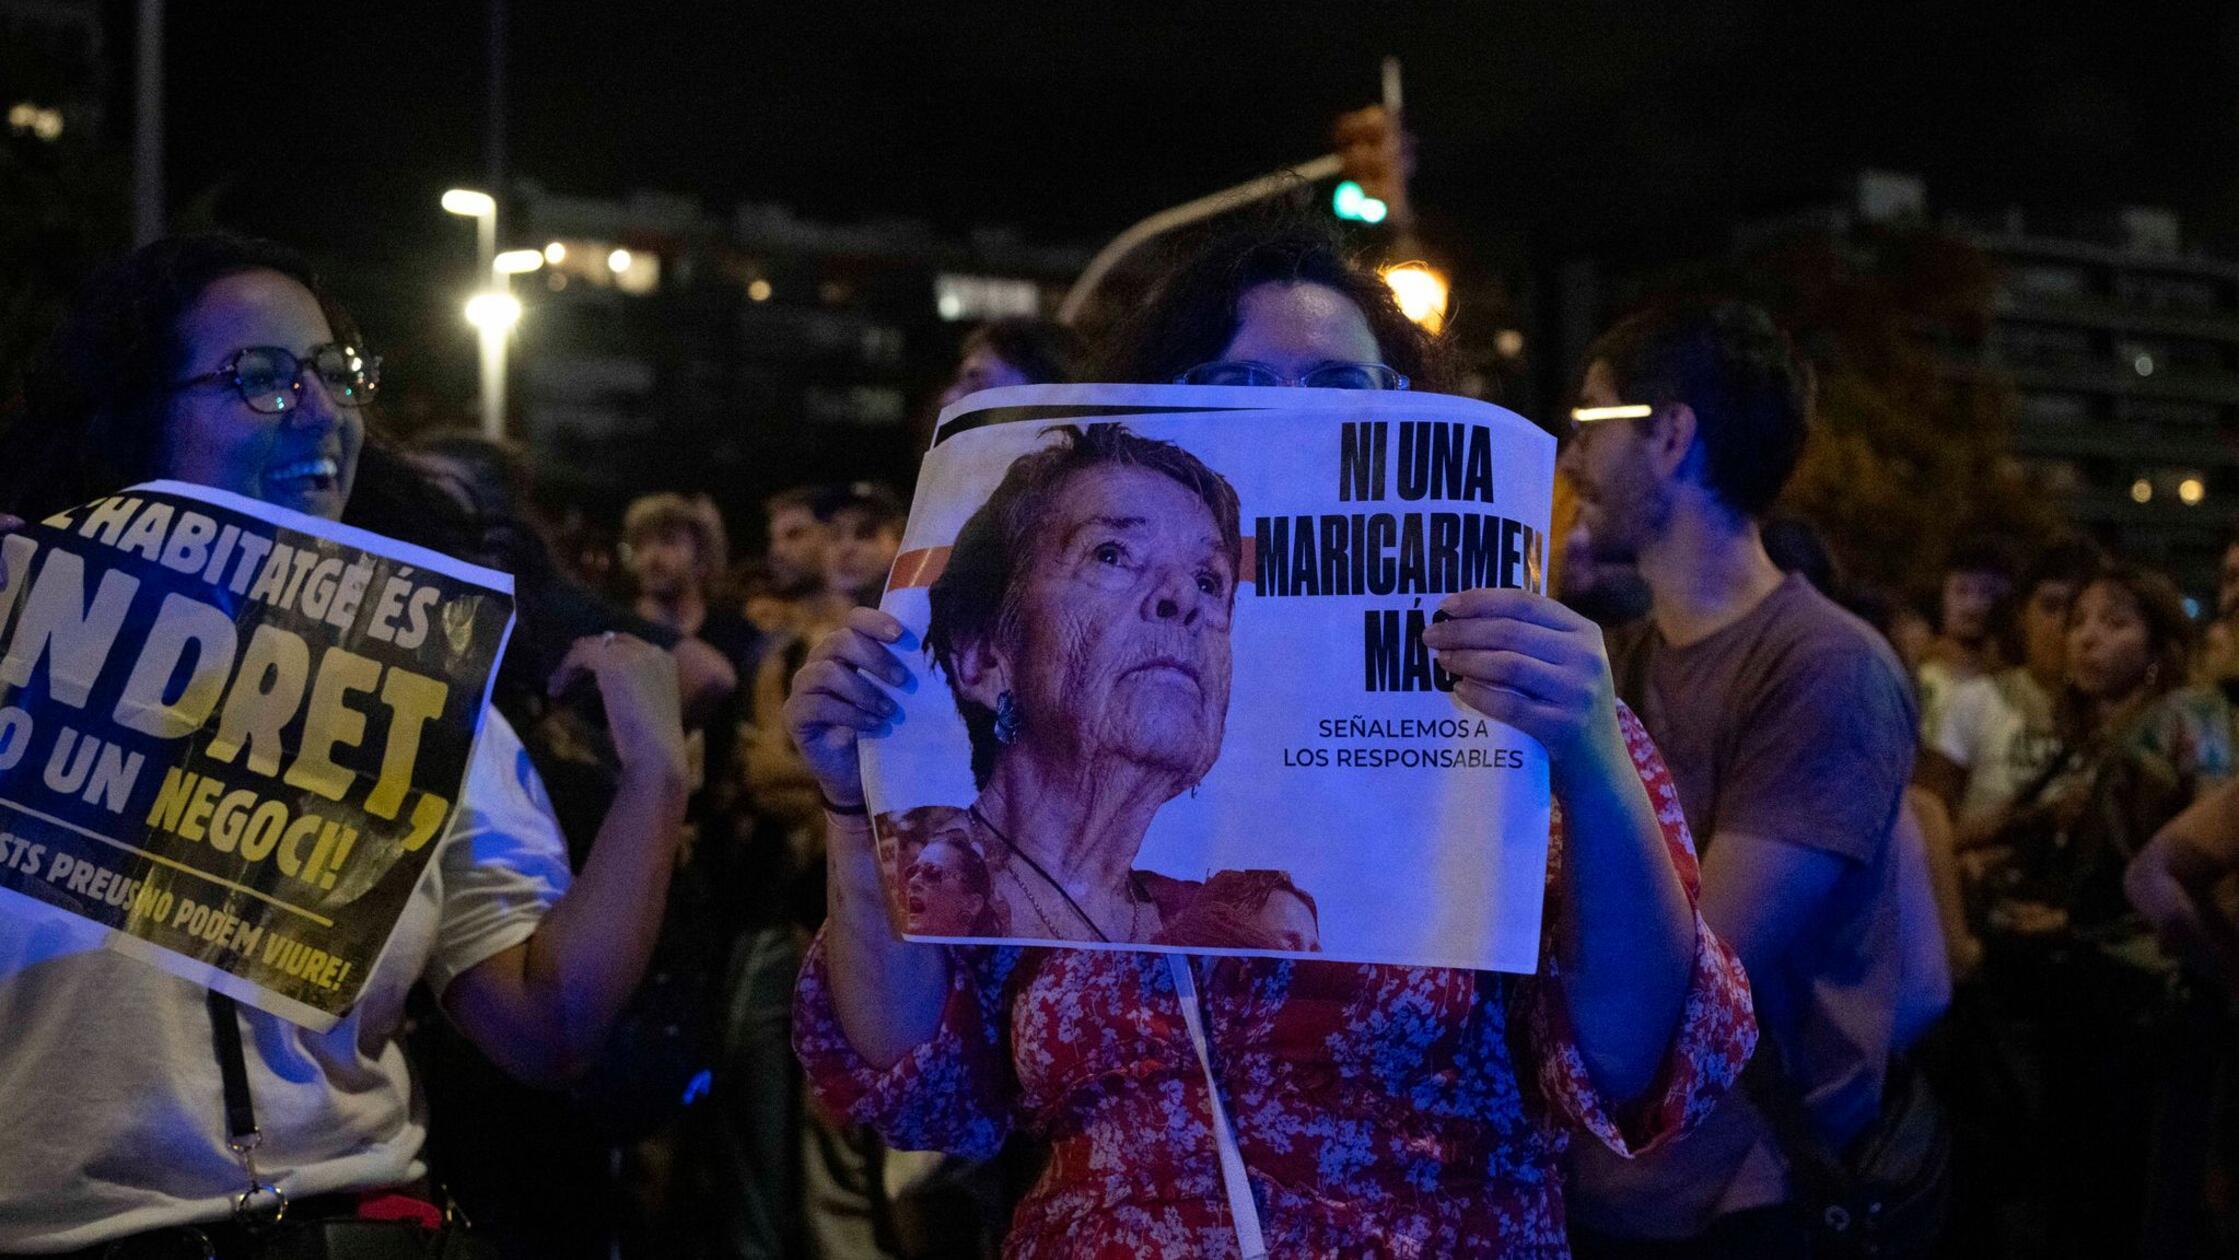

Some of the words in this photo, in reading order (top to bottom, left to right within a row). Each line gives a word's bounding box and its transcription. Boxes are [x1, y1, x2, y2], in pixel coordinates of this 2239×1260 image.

[1339, 422, 1388, 501] NI
[1397, 421, 1494, 503] UNA
[370, 568, 441, 648] ÉS
[112, 592, 449, 851] DRET,
[1284, 748, 1329, 768] LOS
[1337, 749, 1523, 769] RESPONSABLES
[1319, 715, 1469, 738] SEÑALEMOS
[1475, 720, 1488, 738] A
[43, 725, 146, 814] UN
[145, 766, 359, 890] NEGOCI!
[171, 898, 264, 957] PODEM
[262, 932, 352, 992] VIURE!
